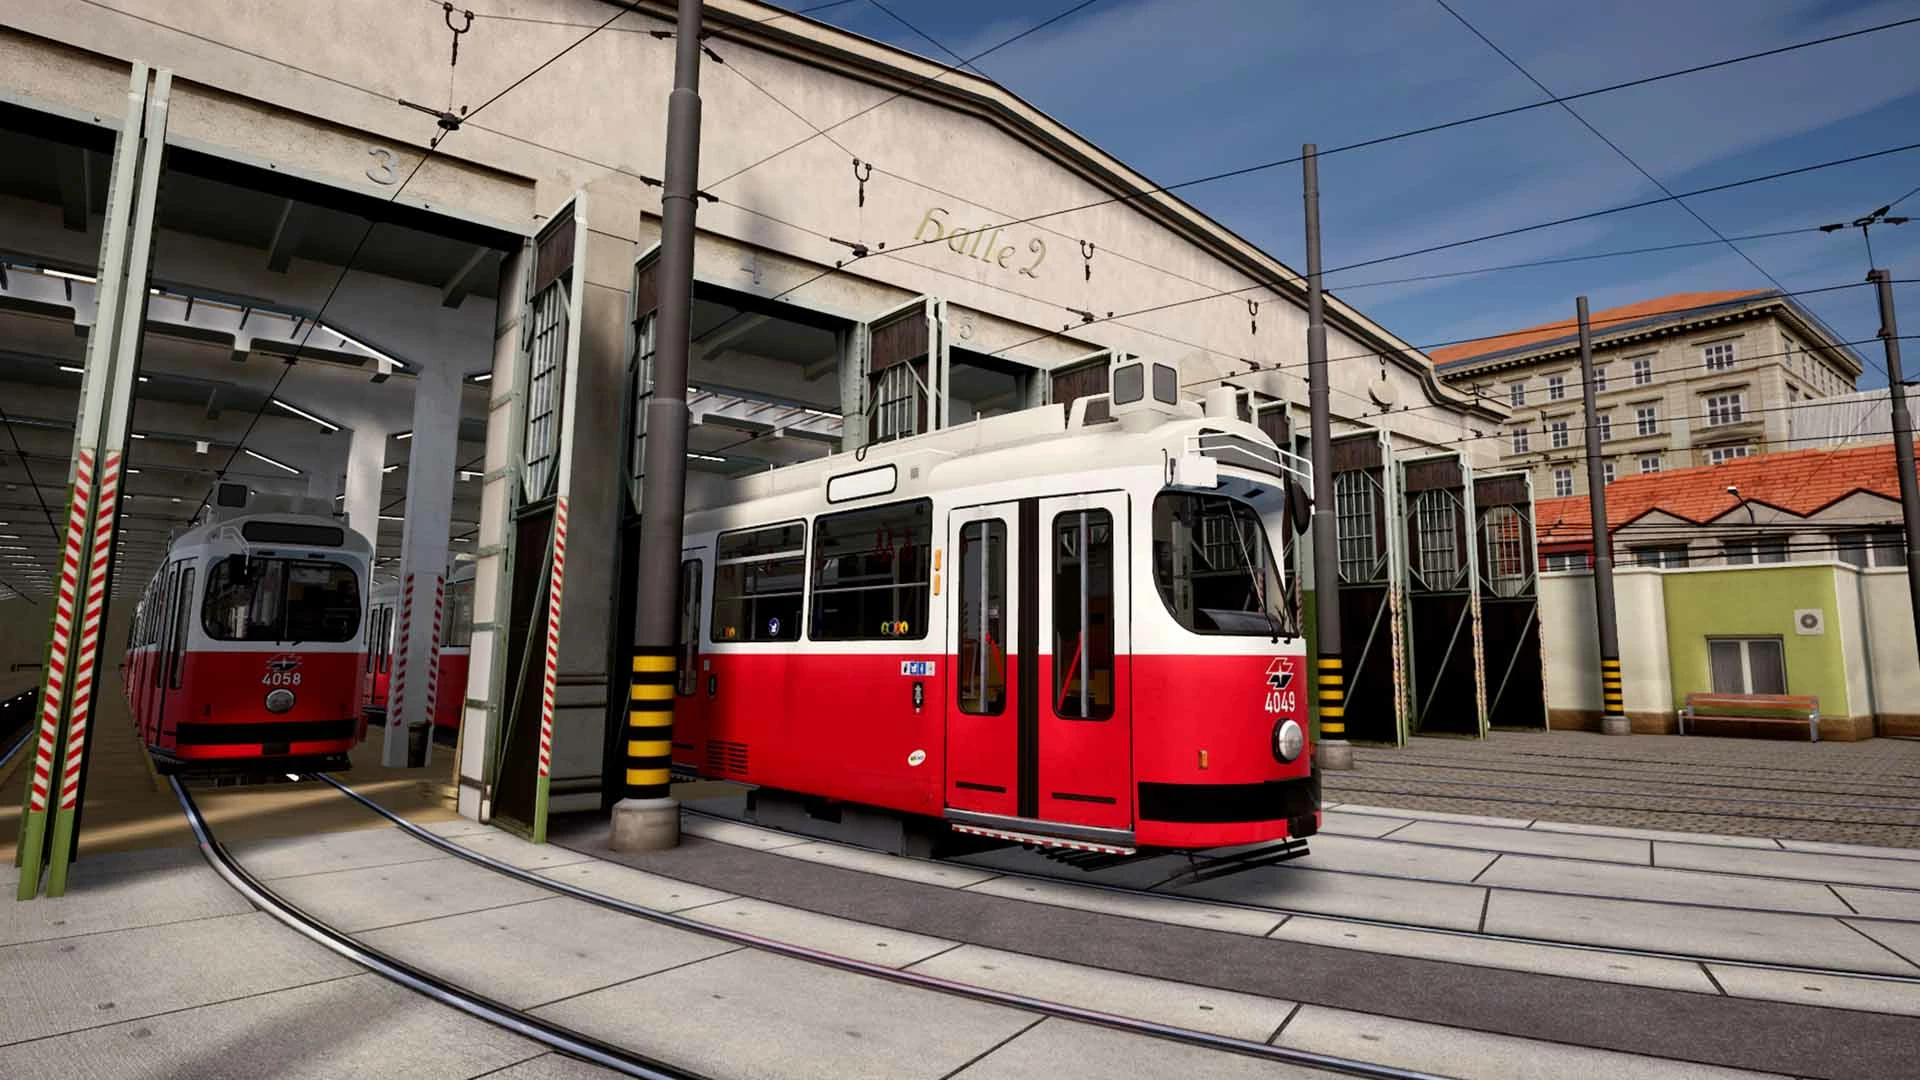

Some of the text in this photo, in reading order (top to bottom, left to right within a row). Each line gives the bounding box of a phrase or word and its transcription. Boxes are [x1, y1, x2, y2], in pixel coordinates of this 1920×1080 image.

[366, 145, 400, 185] 3
[914, 207, 1046, 279] Halle 2
[262, 672, 301, 686] 4058
[1264, 691, 1296, 713] 4049
